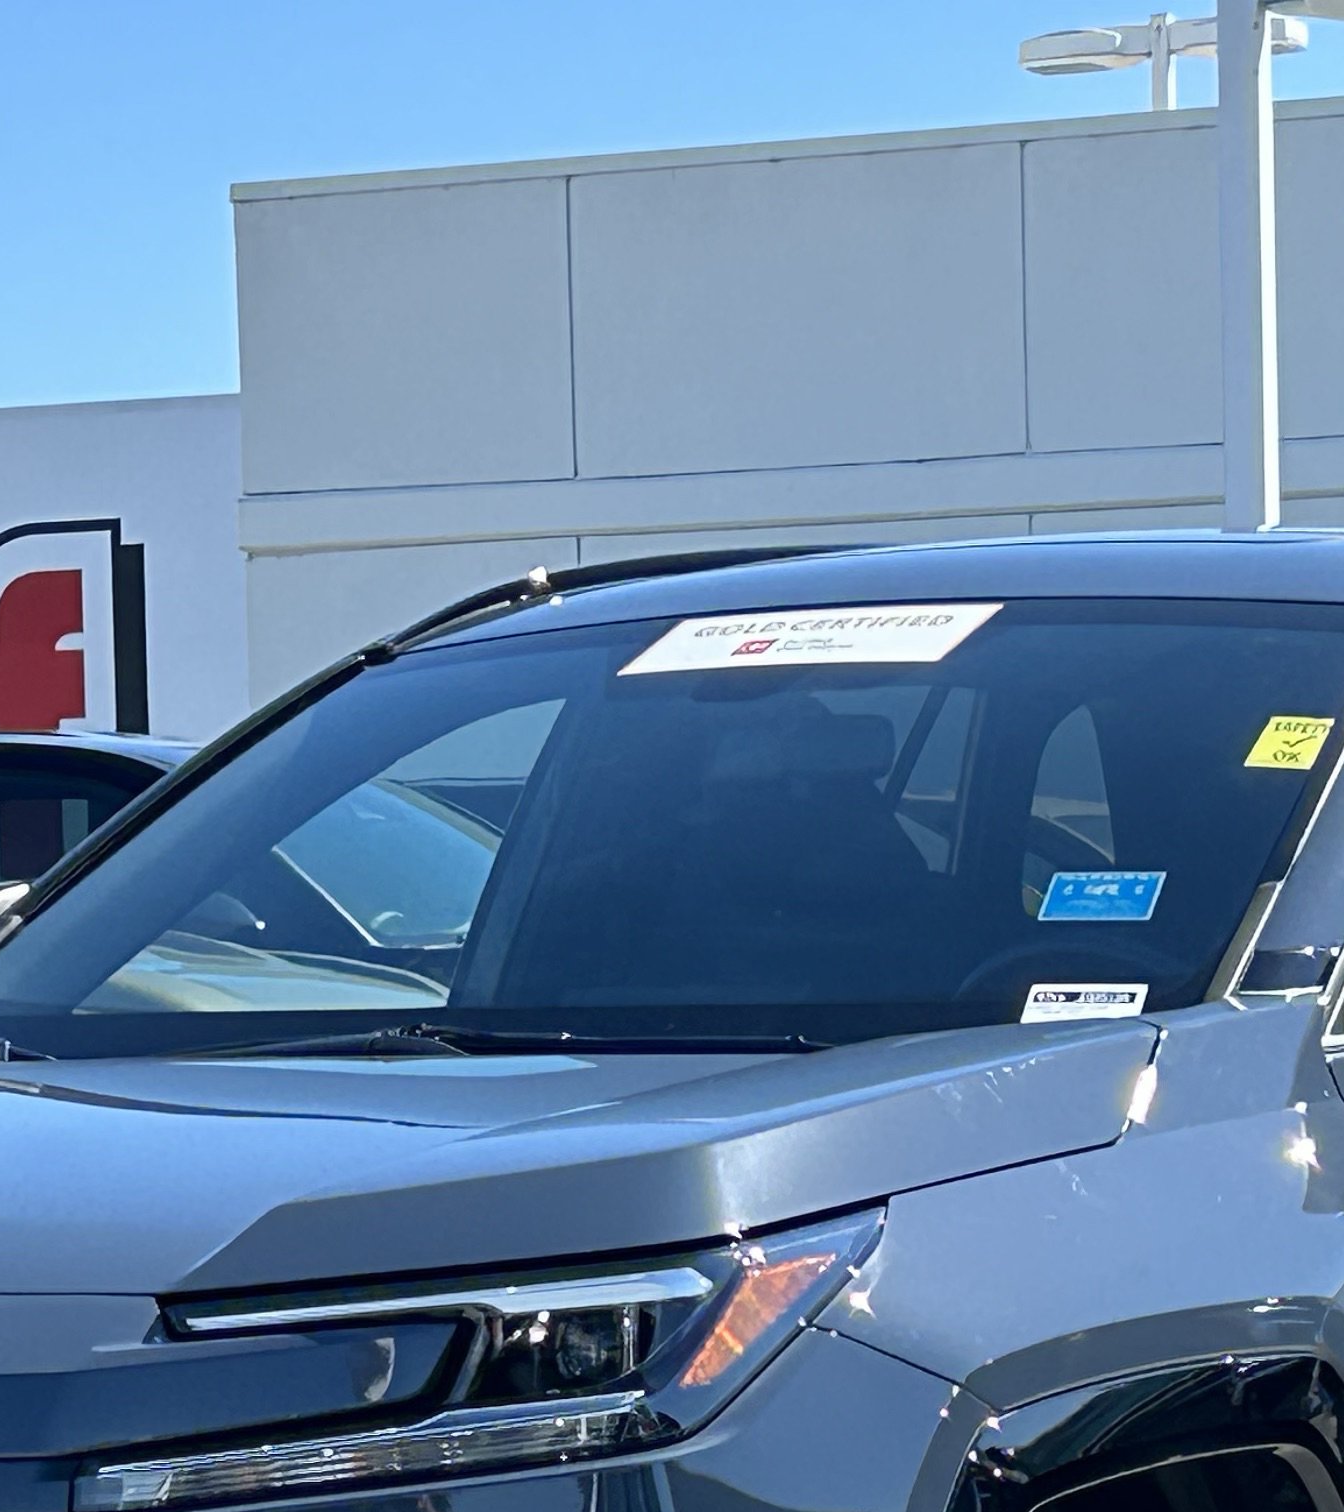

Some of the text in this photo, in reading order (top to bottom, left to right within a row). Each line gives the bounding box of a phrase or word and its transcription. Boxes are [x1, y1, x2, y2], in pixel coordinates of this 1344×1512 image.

[693, 613, 955, 639] GOLD CERTIFIED
[1272, 749, 1302, 763] OK
